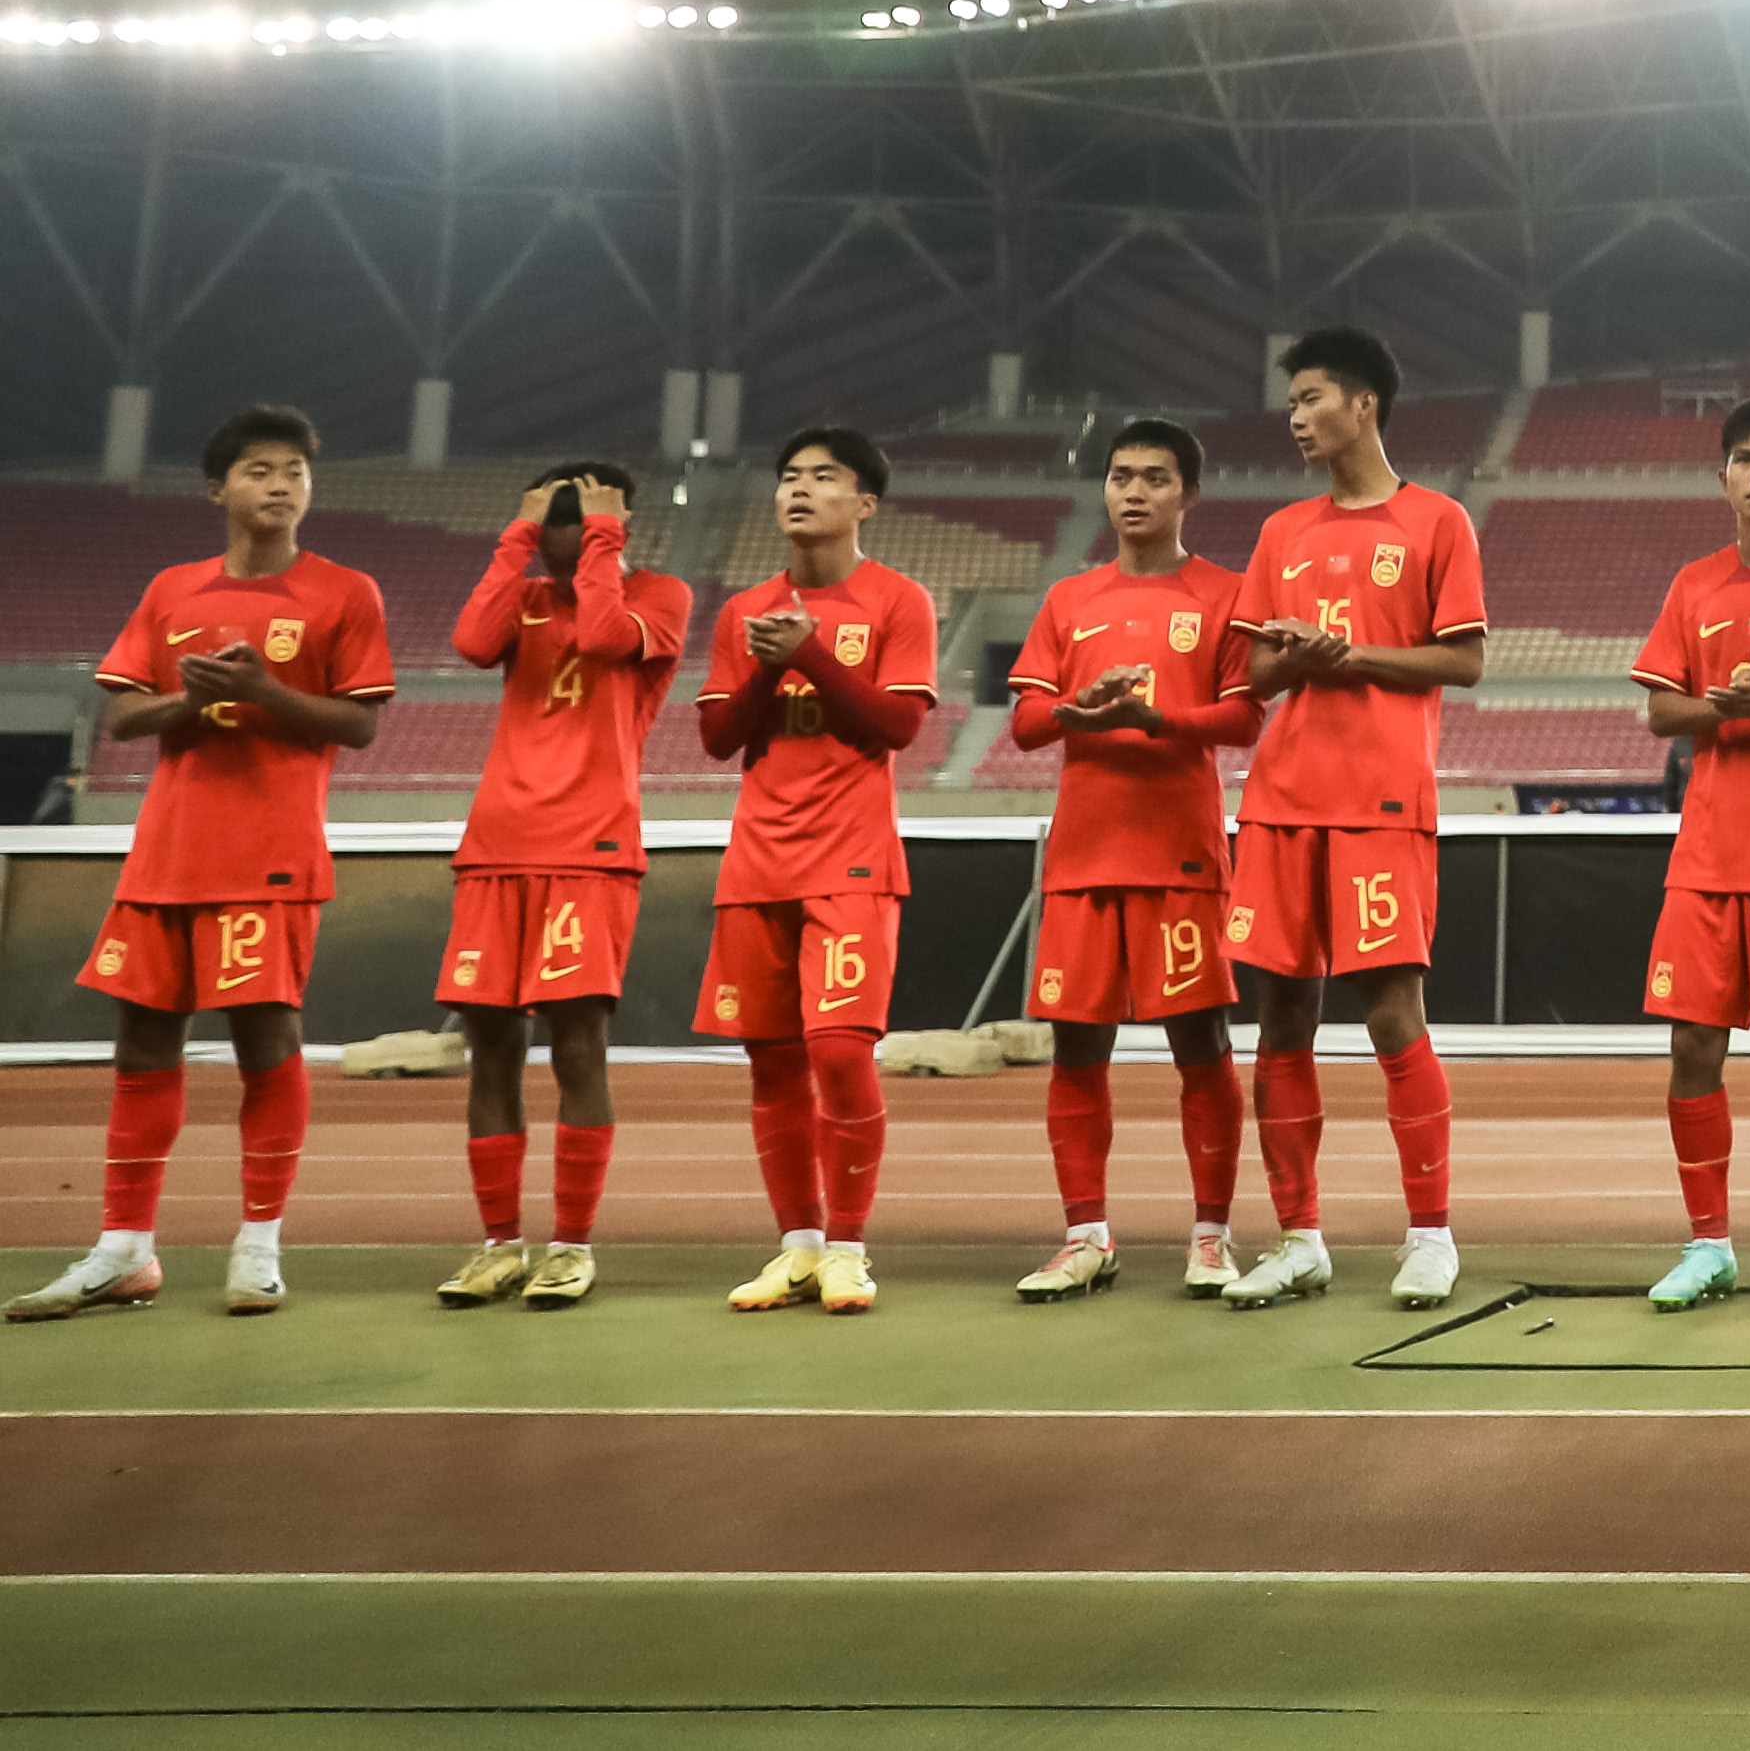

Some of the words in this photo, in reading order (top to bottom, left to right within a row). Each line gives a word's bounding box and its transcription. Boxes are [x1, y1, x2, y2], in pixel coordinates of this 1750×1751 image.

[1316, 598, 1352, 646] 15
[542, 901, 584, 959] 14
[1352, 872, 1399, 931] 15
[217, 911, 267, 969] 12
[823, 934, 866, 990] 16
[1160, 919, 1204, 976] 19
